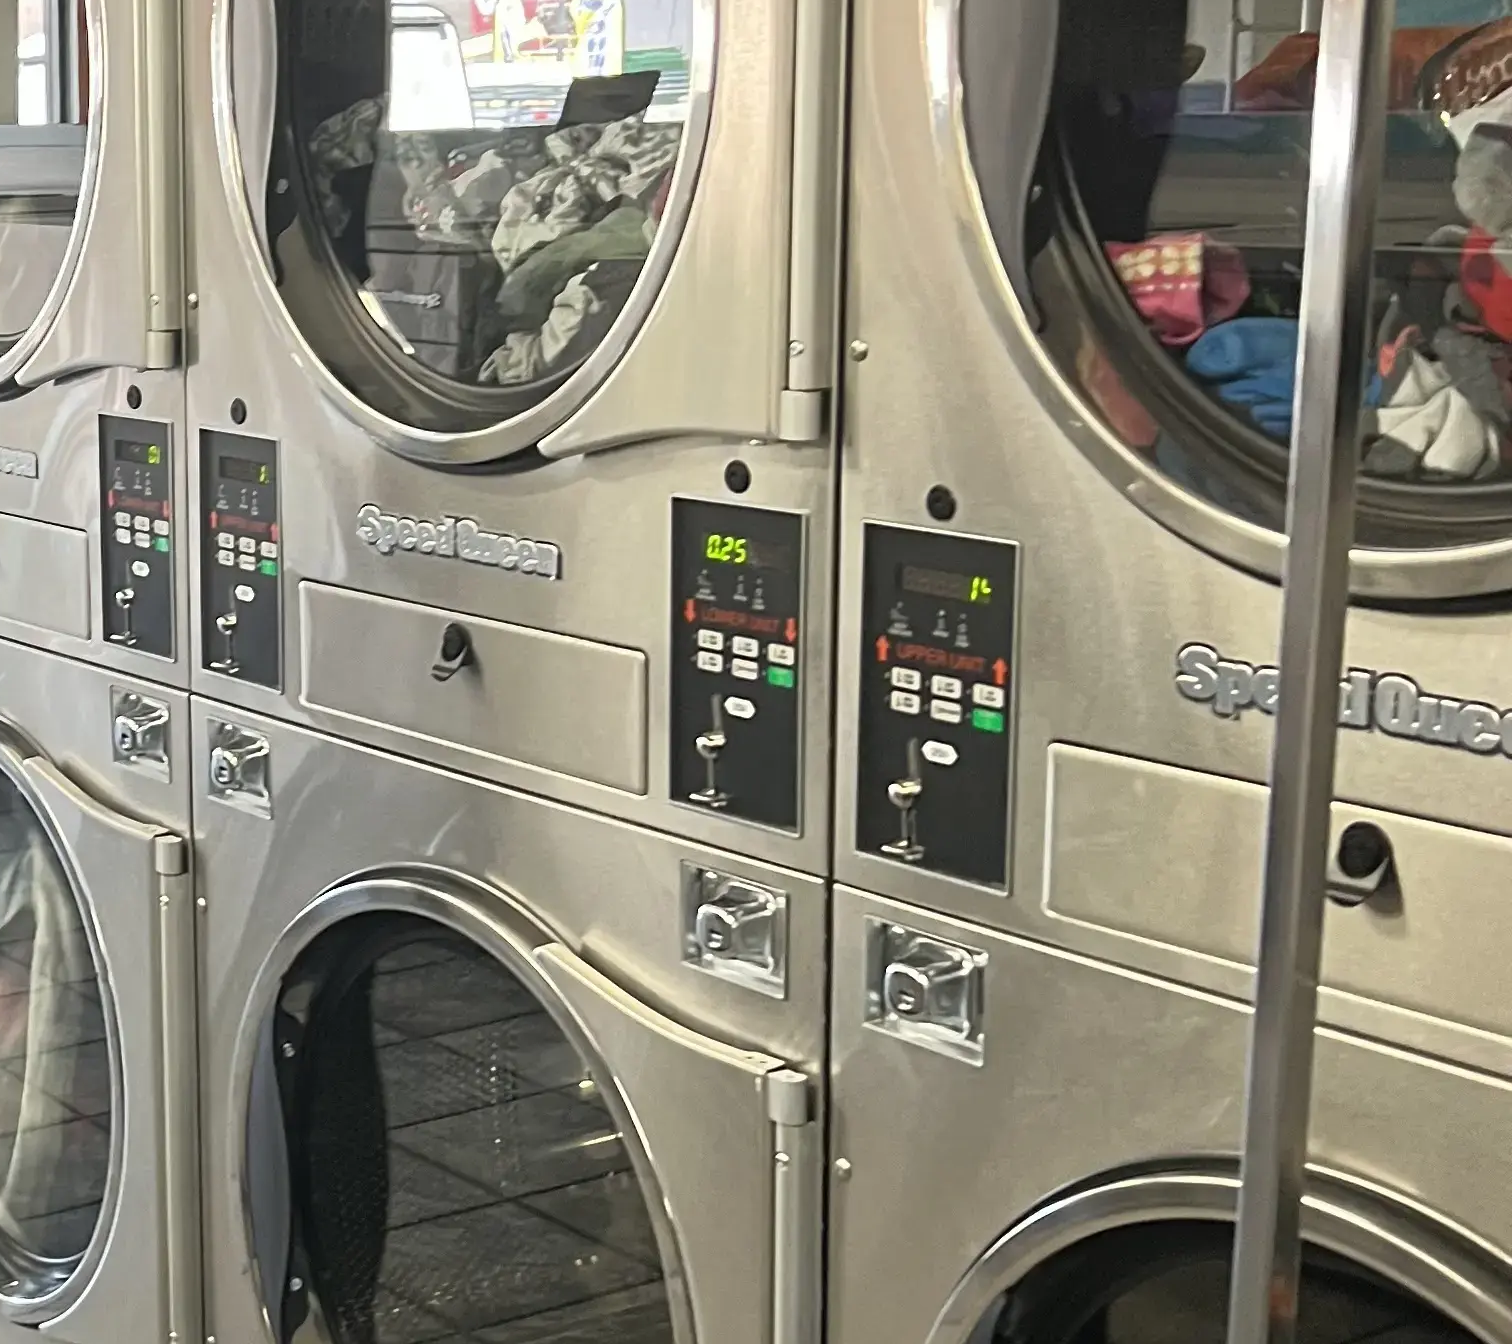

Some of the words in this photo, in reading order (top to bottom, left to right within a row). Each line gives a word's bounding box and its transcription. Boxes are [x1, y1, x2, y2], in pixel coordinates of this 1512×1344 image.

[356, 503, 457, 557] Speed
[457, 516, 562, 580] Queen
[1176, 642, 1374, 729] Sped
